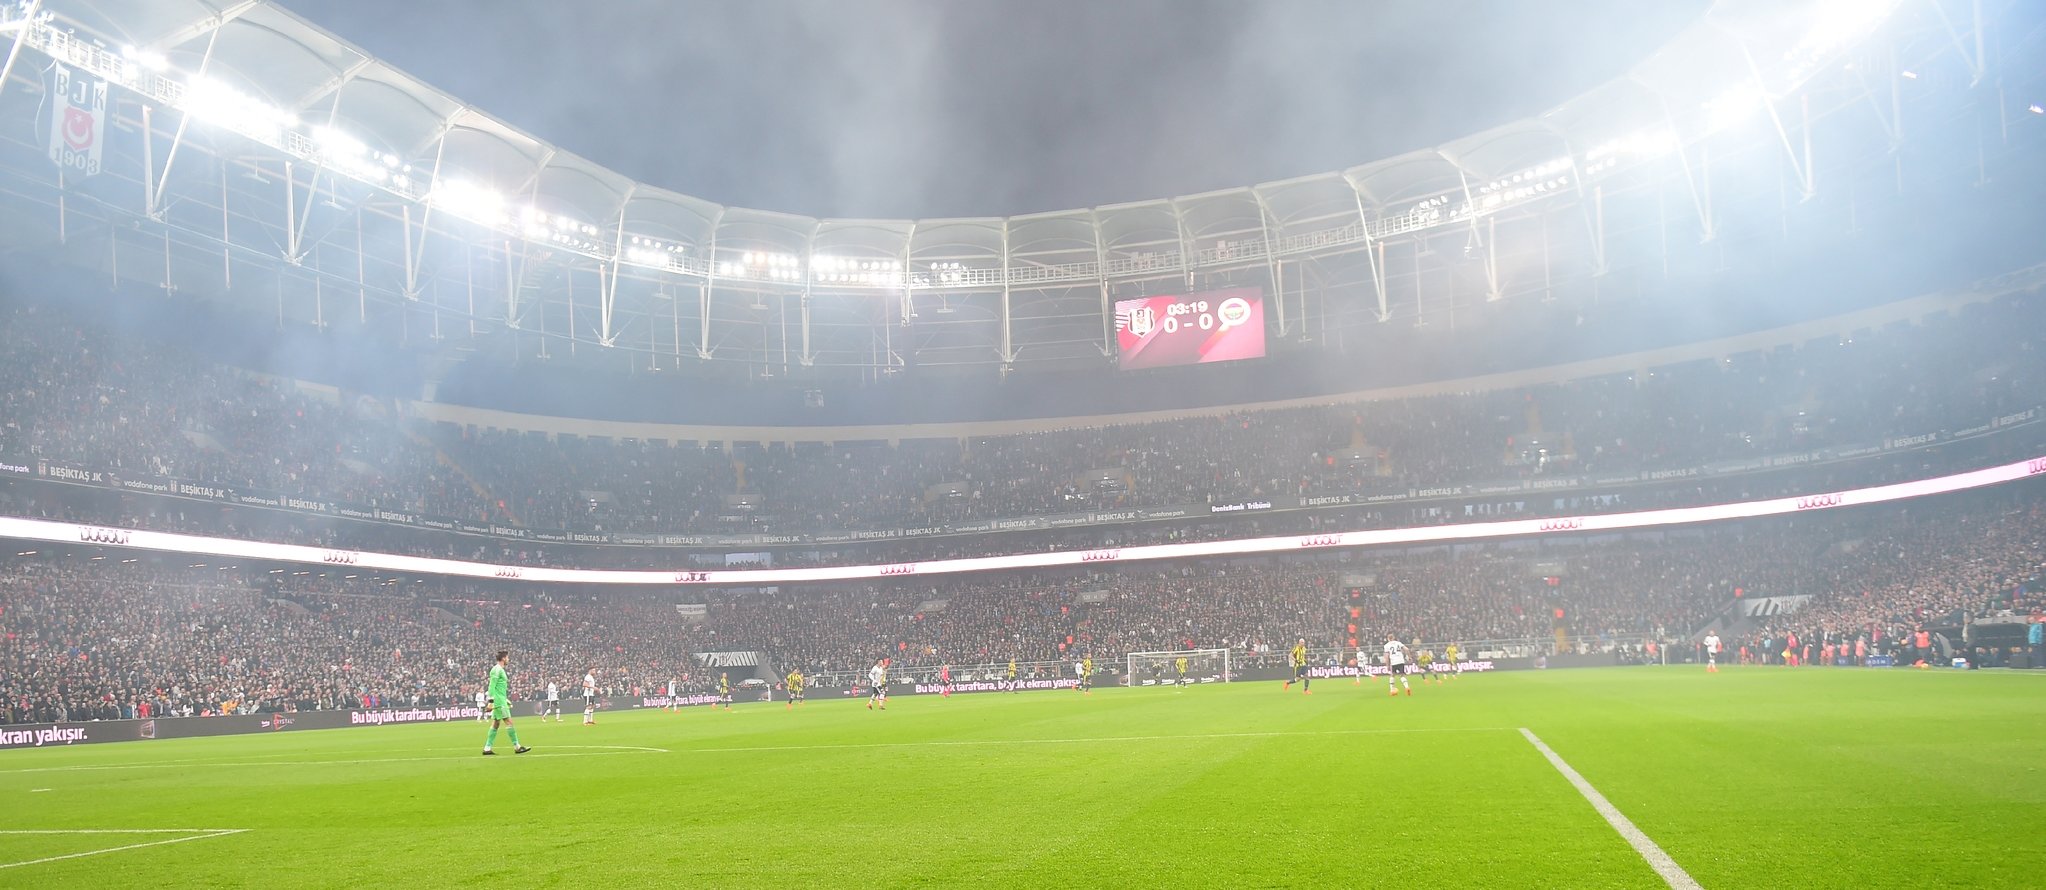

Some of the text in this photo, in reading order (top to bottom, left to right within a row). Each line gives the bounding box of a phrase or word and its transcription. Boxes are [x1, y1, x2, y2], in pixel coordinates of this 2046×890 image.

[51, 147, 98, 173] 1903
[1167, 301, 1208, 316] 03:19
[1164, 317, 1178, 334] 0
[1199, 313, 1213, 330] 0
[14, 464, 30, 473] park
[50, 466, 102, 482] BEŞİKTAŞ JK
[124, 480, 168, 492] vodafone park
[180, 484, 224, 498] BEŞİKTAŞ JK
[288, 498, 326, 512] BEŞİKTAŞ JK
[1212, 501, 1271, 512] DenizBank Tribünü
[1796, 493, 1844, 509] DUGOUT
[1126, 511, 1134, 519] JK
[1301, 534, 1344, 546] DUGOUT
[1390, 645, 1401, 654] 24
[1312, 666, 1344, 678] büyük
[1456, 660, 1494, 672] yakışır.
[916, 684, 928, 694] Bu
[956, 681, 996, 692] taraftara,
[1026, 679, 1052, 688] ekran
[352, 711, 364, 724] Bu
[366, 710, 395, 725] büyük
[395, 708, 435, 721] taraftara,
[436, 706, 460, 721] büyük
[0, 725, 88, 746] kran yakışır.
